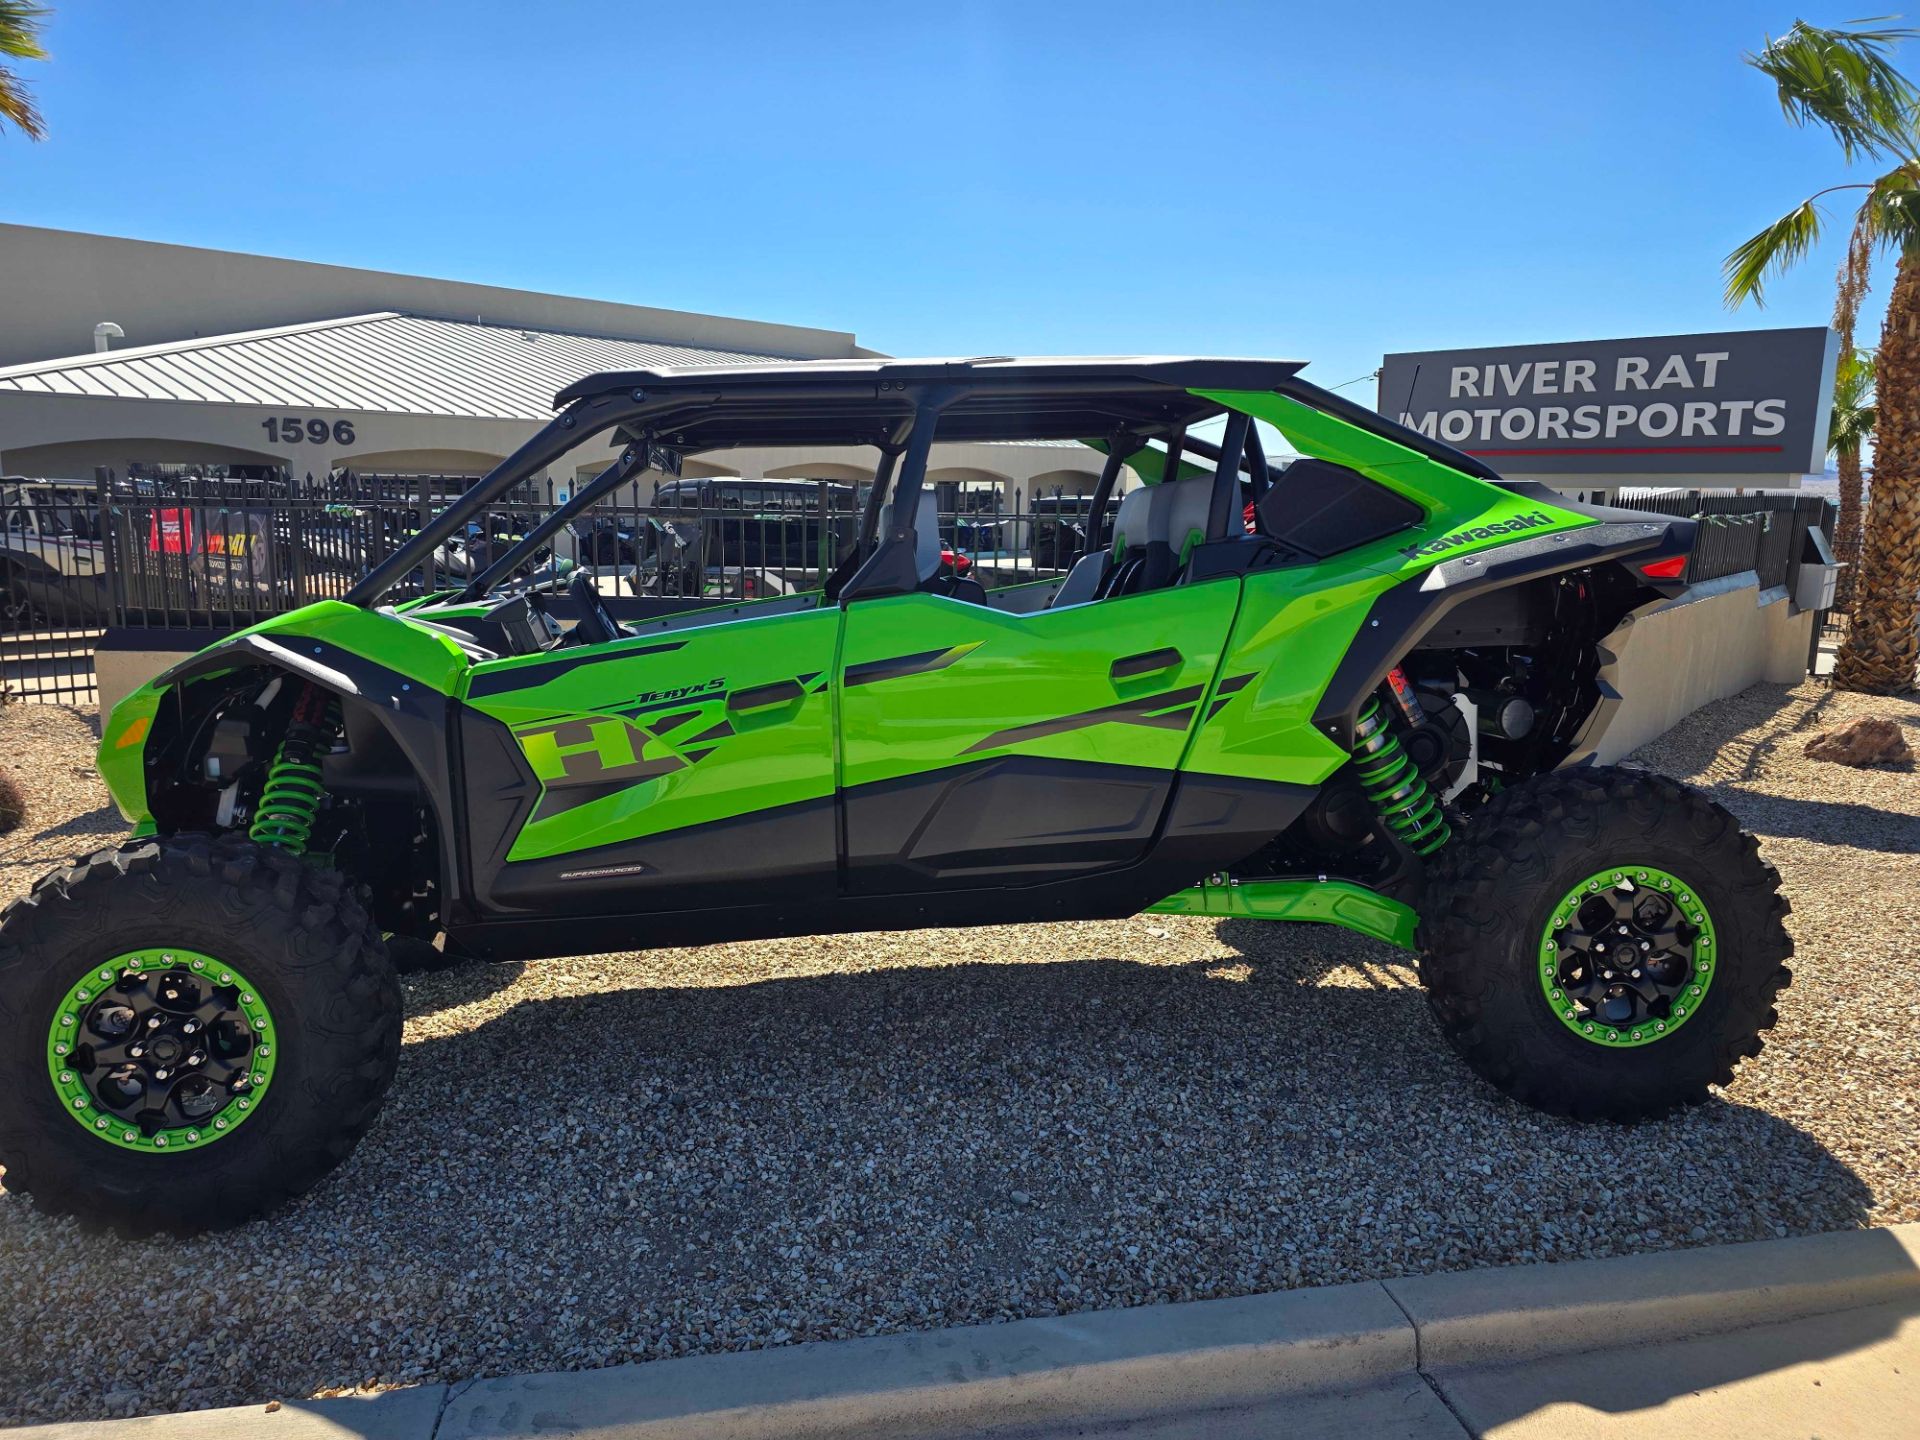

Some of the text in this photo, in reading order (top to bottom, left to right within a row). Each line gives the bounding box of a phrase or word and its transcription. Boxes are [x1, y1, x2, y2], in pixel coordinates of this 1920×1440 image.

[1449, 351, 1730, 398] RIVER RAT
[261, 417, 356, 445] 1596
[1400, 399, 1787, 442] MOTORSPORTS
[1398, 511, 1555, 560] Kawasaki
[560, 866, 642, 878] SUPERCHARGED
